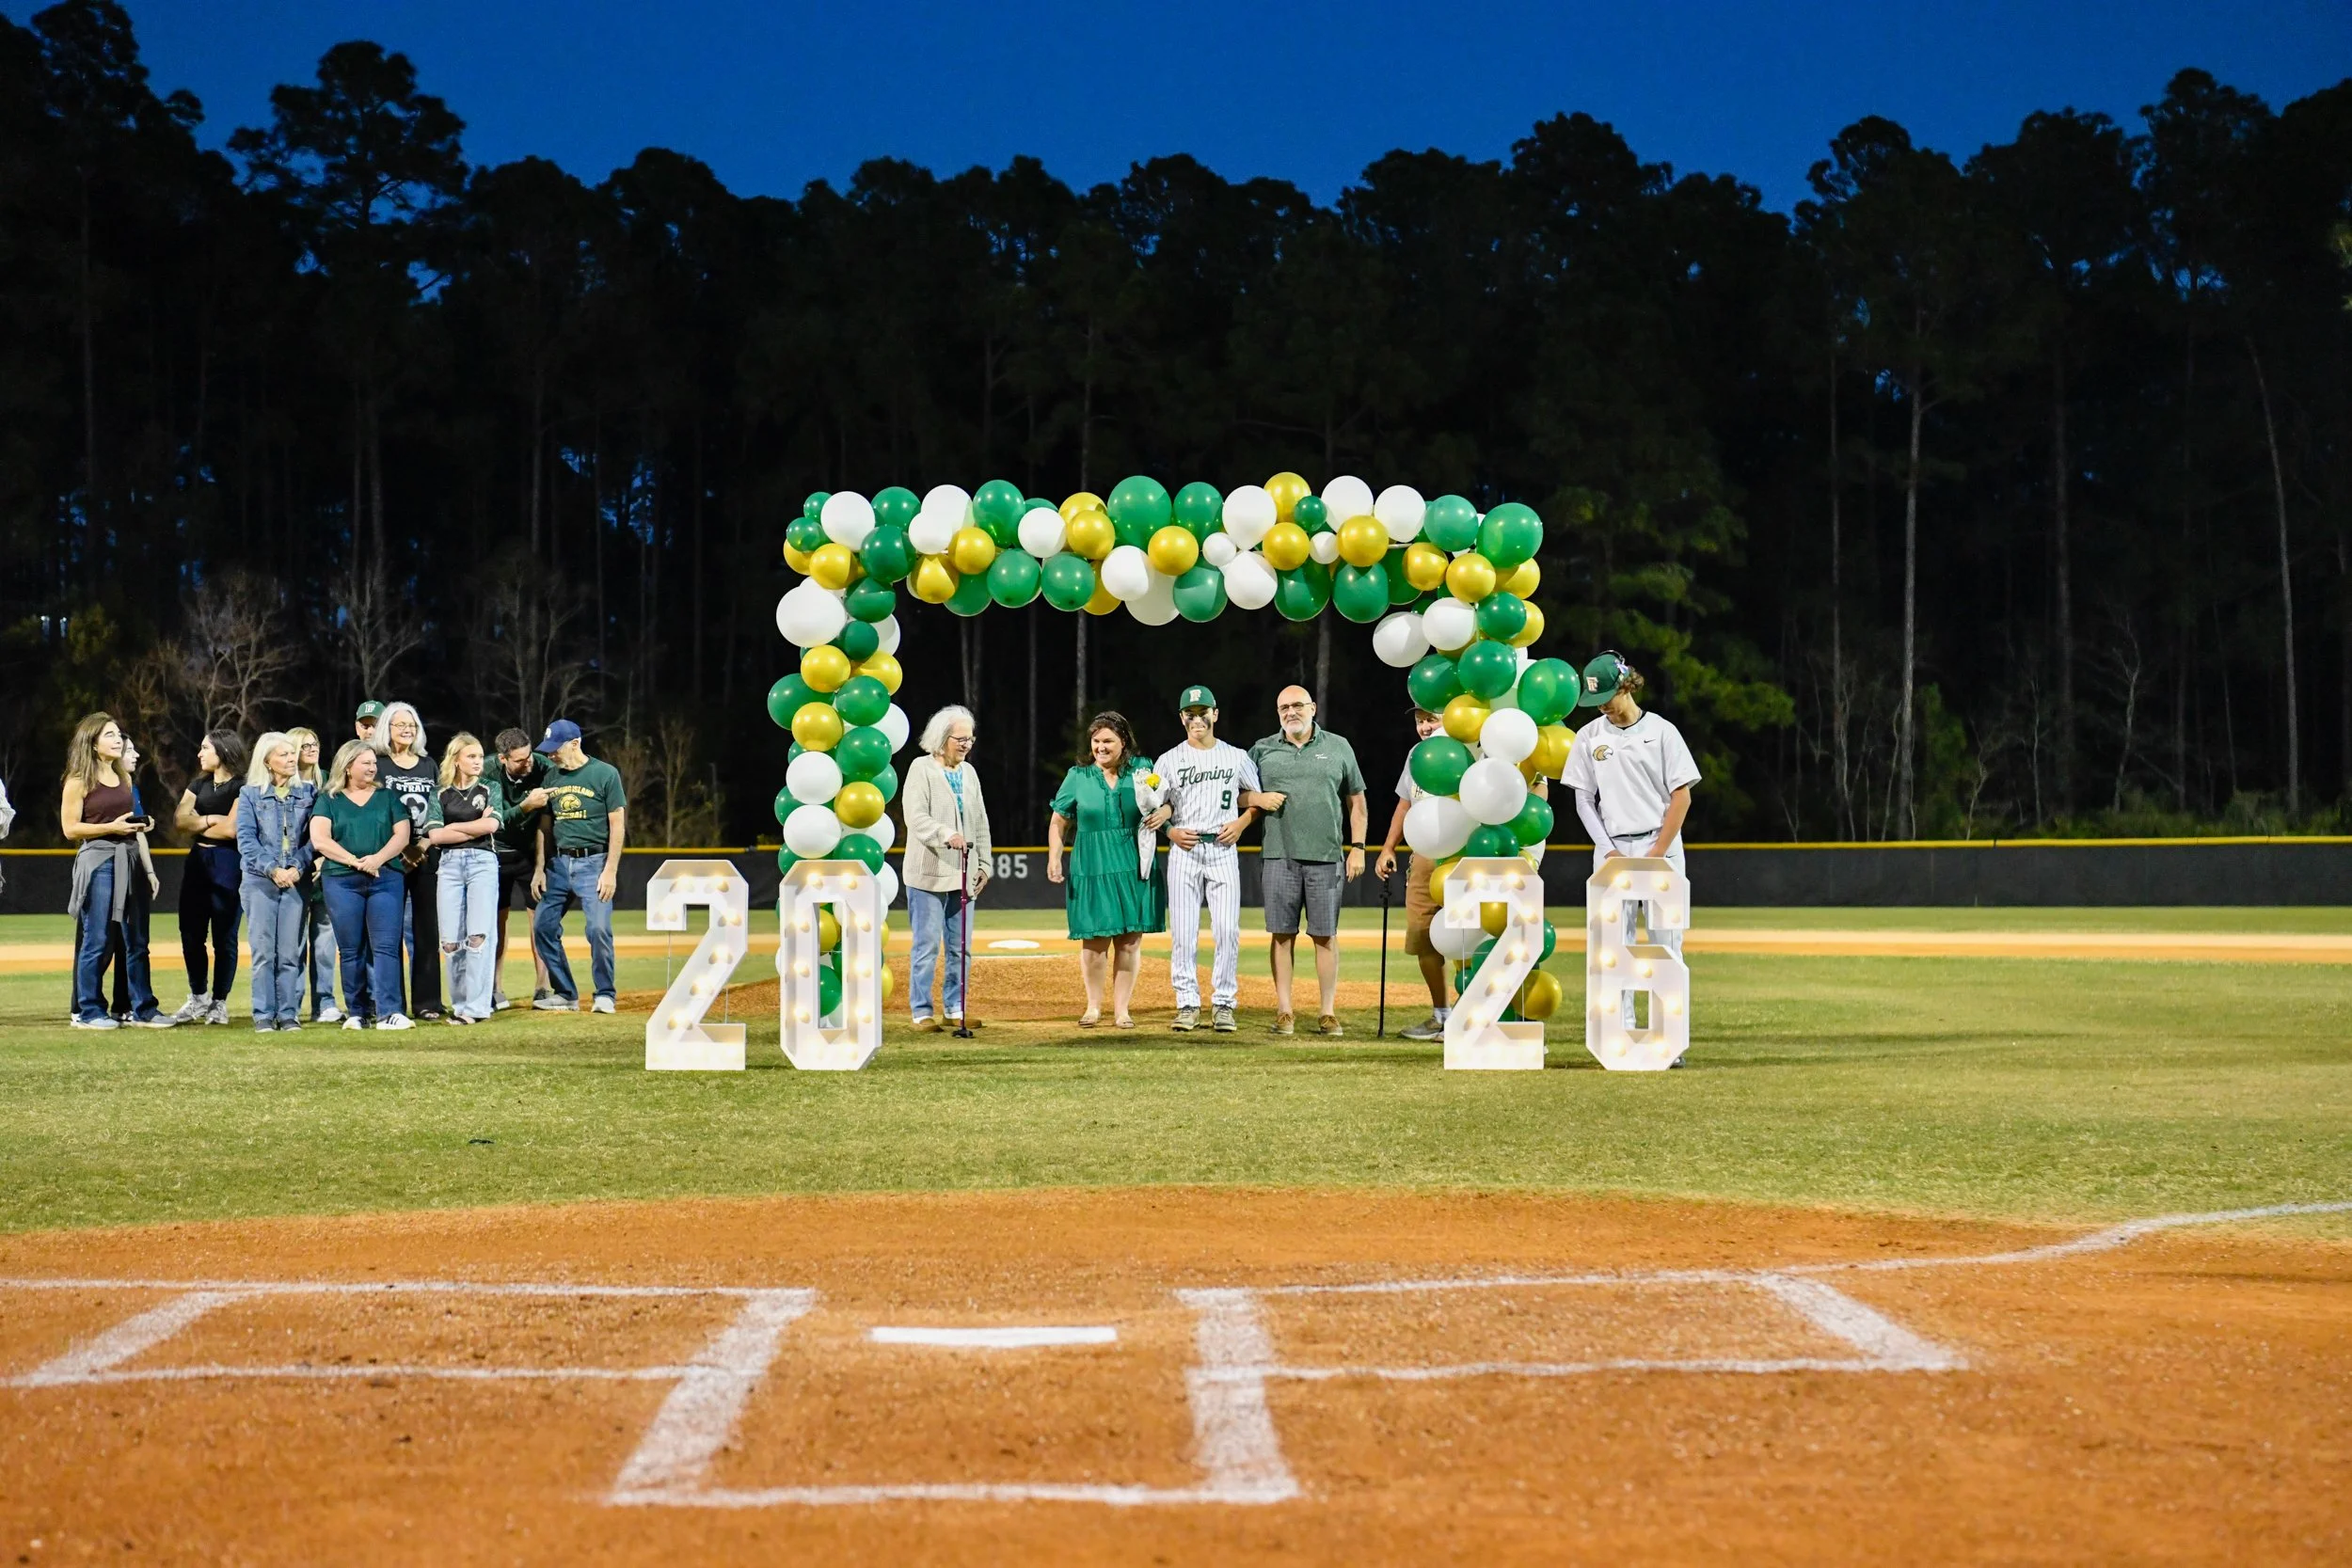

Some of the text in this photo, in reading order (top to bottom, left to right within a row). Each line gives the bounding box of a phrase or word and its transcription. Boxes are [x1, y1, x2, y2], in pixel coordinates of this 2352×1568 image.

[1177, 765, 1234, 788] Fleming
[396, 783, 431, 793] STRAIT
[572, 784, 595, 798] ISLAND
[1221, 790, 1232, 810] 9
[645, 857, 1691, 1071] 20 26
